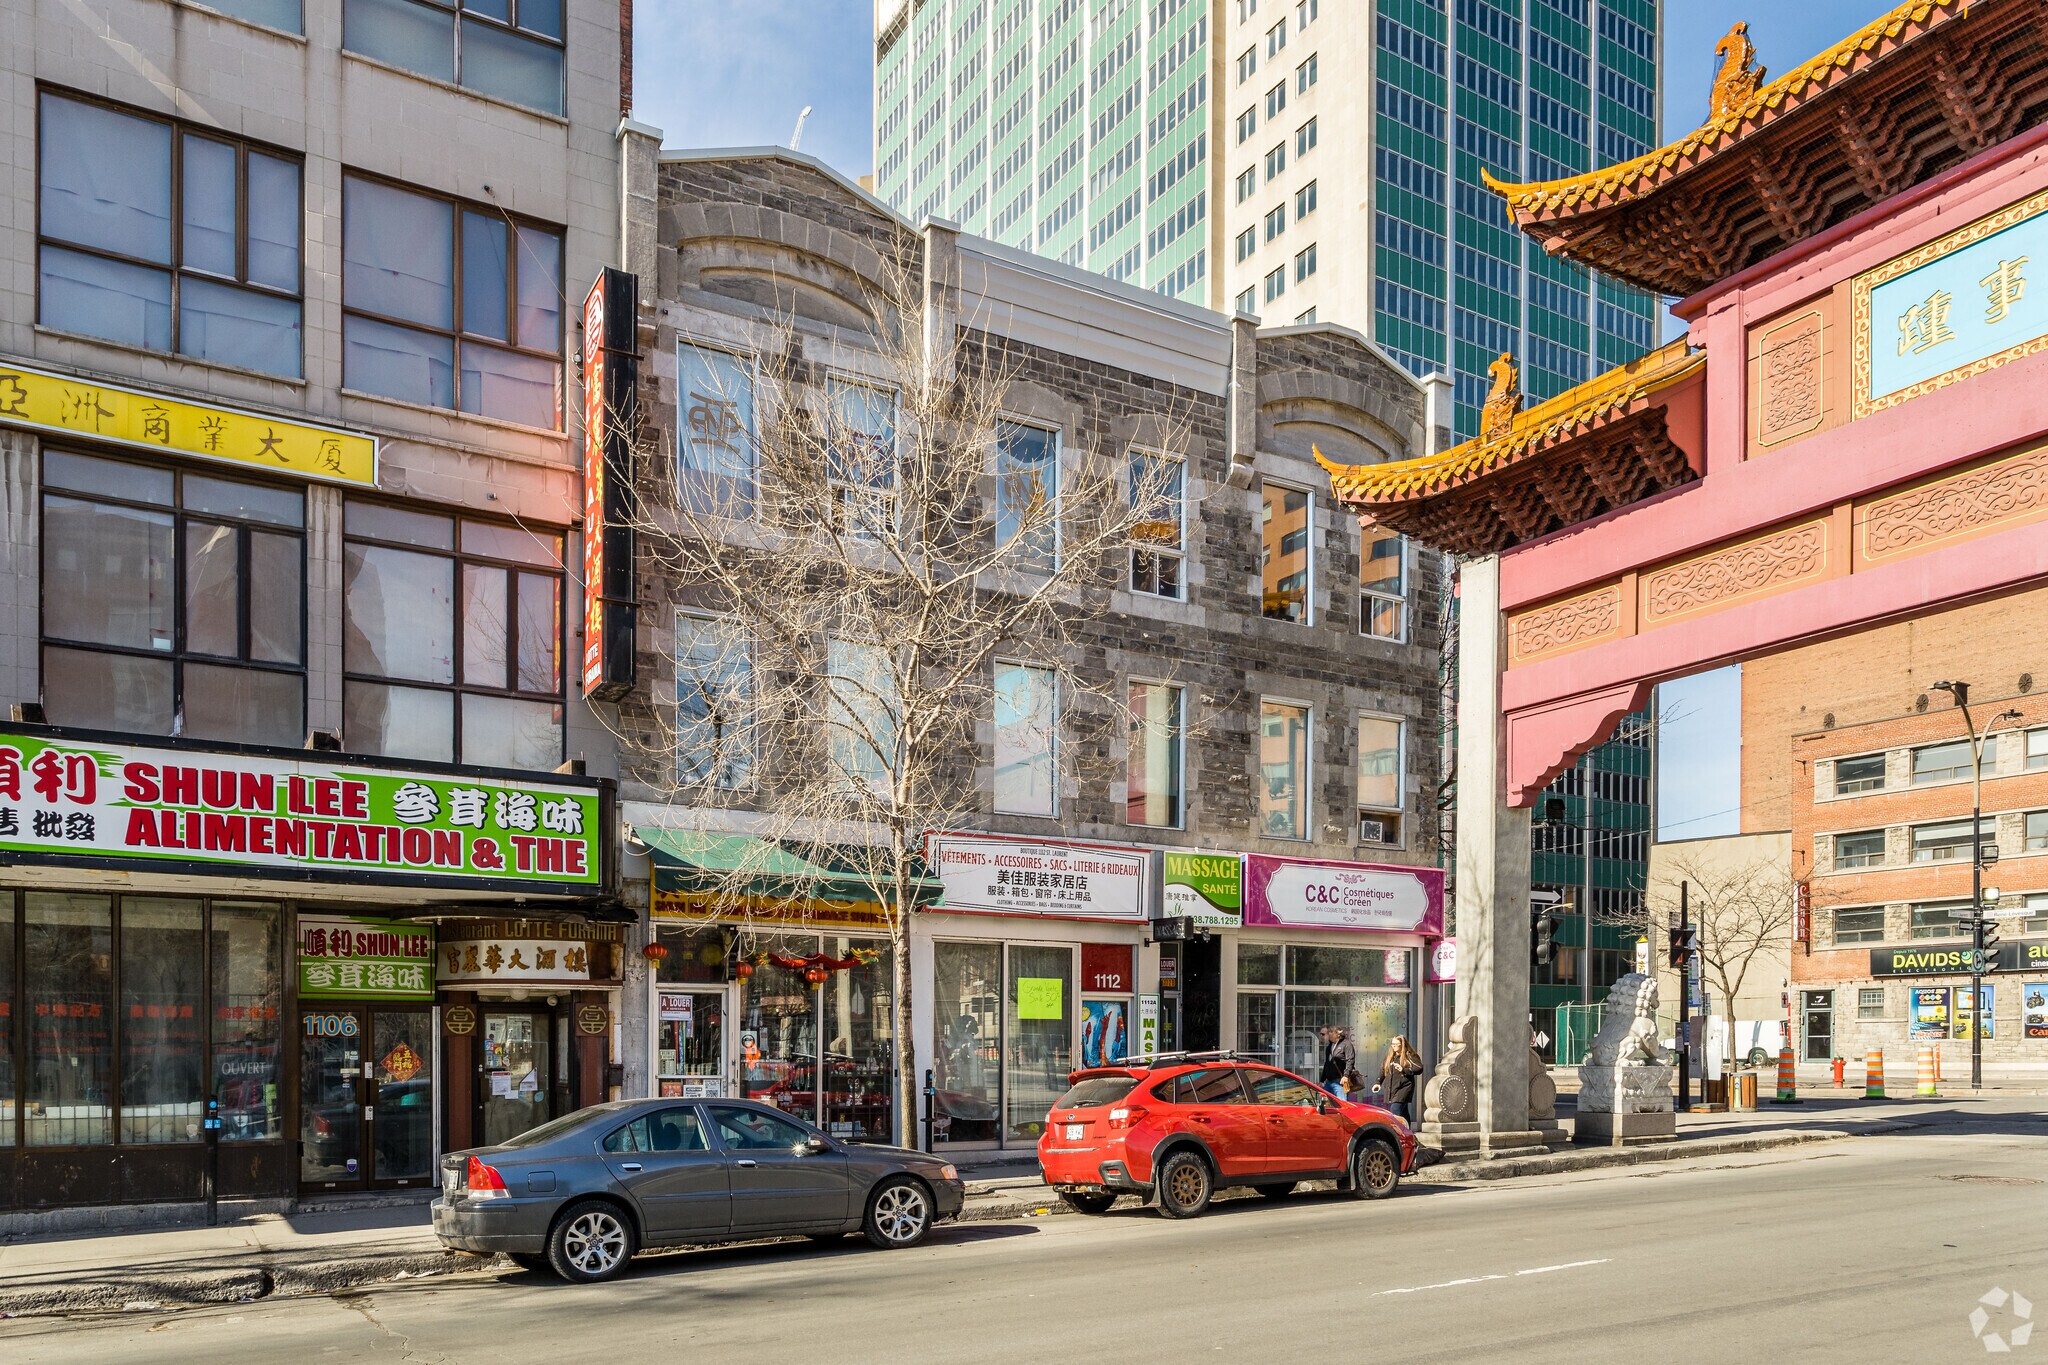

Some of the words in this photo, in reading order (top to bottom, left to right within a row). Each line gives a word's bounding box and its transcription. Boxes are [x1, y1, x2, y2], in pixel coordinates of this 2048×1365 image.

[585, 375, 594, 642] RESTAURANT
[123, 762, 275, 811] SHUN
[288, 776, 368, 819] LEE
[125, 808, 462, 867] ALIMENTATION
[471, 837, 503, 869] &
[511, 835, 586, 874] THE
[941, 848, 986, 865] VÊTEMENTS
[994, 854, 1042, 869] ACCESSOIRES
[1050, 859, 1067, 872] SACS
[1074, 861, 1099, 874] LITERIE
[1101, 863, 1106, 874] &
[1107, 863, 1139, 877] RIDEAUX
[1168, 857, 1239, 879] MASSAGE
[997, 869, 1088, 890] 美佳服装家居店
[1202, 883, 1238, 895] SANTÉ
[1305, 884, 1339, 904] C&C
[1344, 886, 1394, 901] Cosmétiques
[1344, 895, 1372, 906] Coréen
[504, 920, 553, 938] LOTTE
[1193, 916, 1239, 925] 38.788.1295
[356, 932, 400, 957] SHUN
[404, 935, 428, 957] LEE
[1437, 951, 1455, 961] C&C
[1893, 951, 1973, 969] DAVIDSO
[1094, 974, 1121, 989] 1112
[670, 998, 690, 1007] LOUER
[303, 1014, 358, 1036] 1106
[222, 1062, 266, 1075] OUVERT
